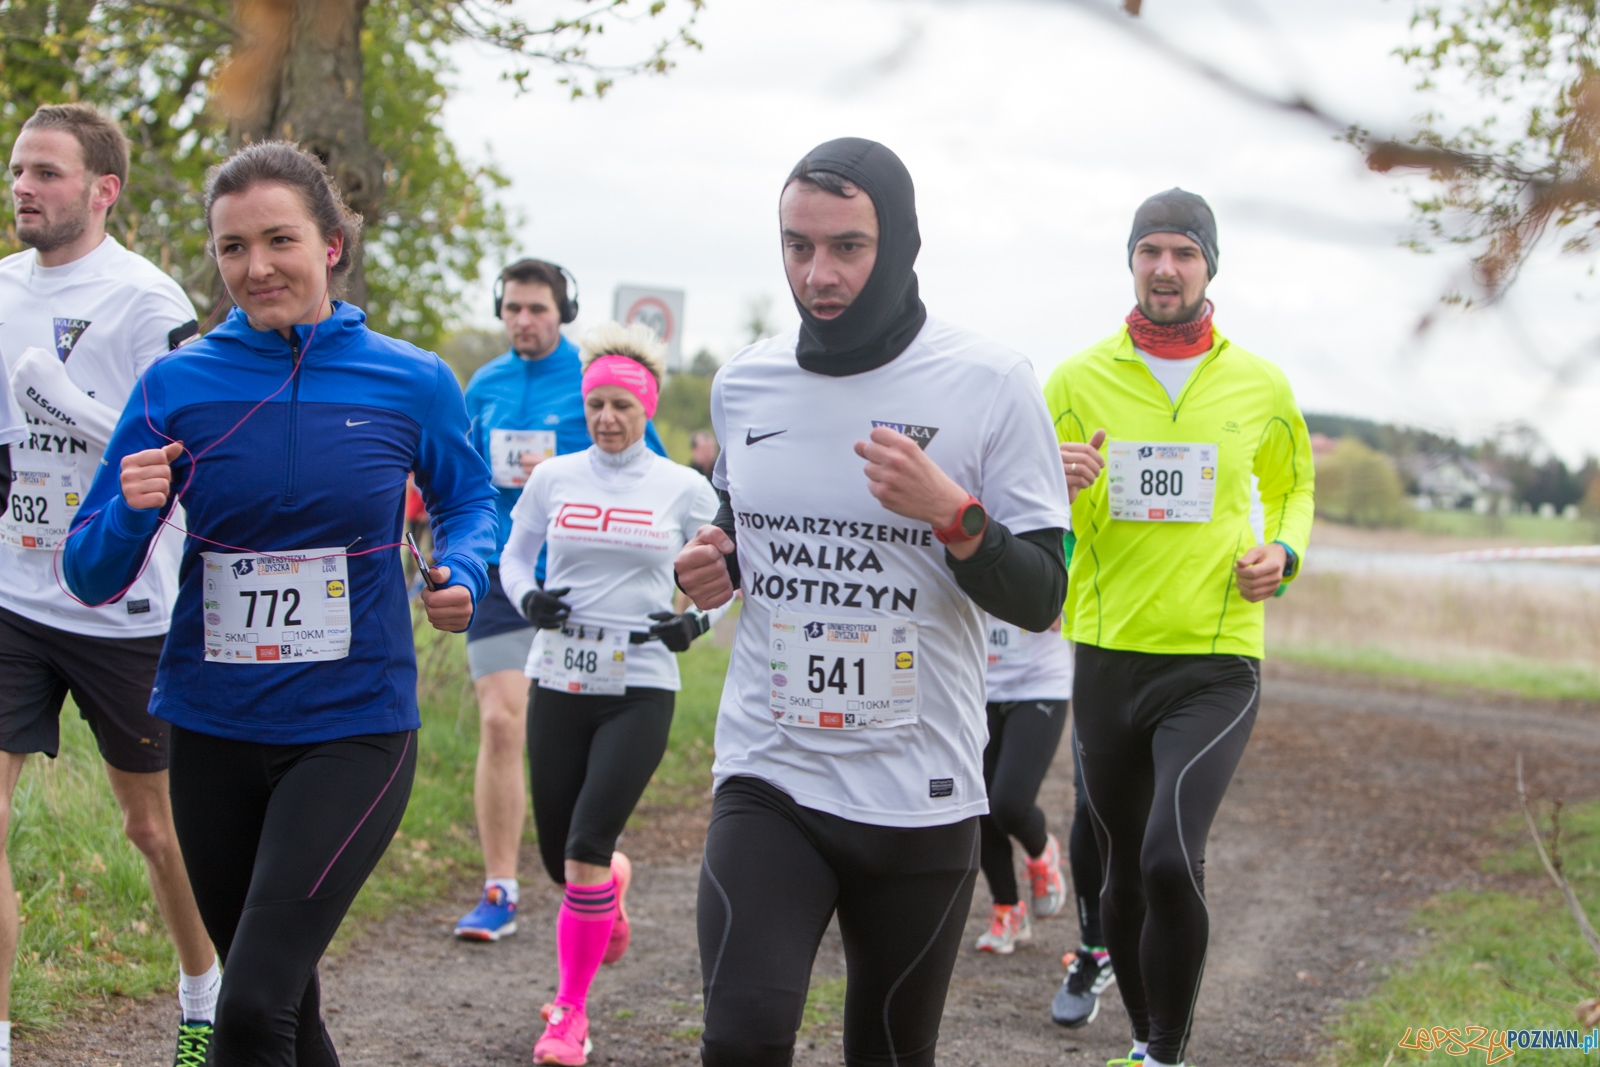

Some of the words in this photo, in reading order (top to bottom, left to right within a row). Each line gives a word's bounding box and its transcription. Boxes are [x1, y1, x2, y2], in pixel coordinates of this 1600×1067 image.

[54, 319, 86, 329] WALKA
[875, 422, 931, 439] ALKA
[1141, 469, 1183, 496] 880
[11, 494, 49, 524] 632
[611, 525, 632, 535] RED
[633, 526, 670, 540] FITNESS
[738, 512, 932, 547] STOWARZYSZENIE
[769, 542, 884, 573] WALKA
[751, 571, 917, 612] KOSTRZYN
[239, 588, 302, 628] 772
[225, 633, 246, 642] 5KM
[295, 630, 324, 641] 10KM
[564, 648, 598, 674] 648
[808, 655, 865, 695] 541
[789, 696, 810, 707] 5KM
[860, 700, 890, 710] 10KM
